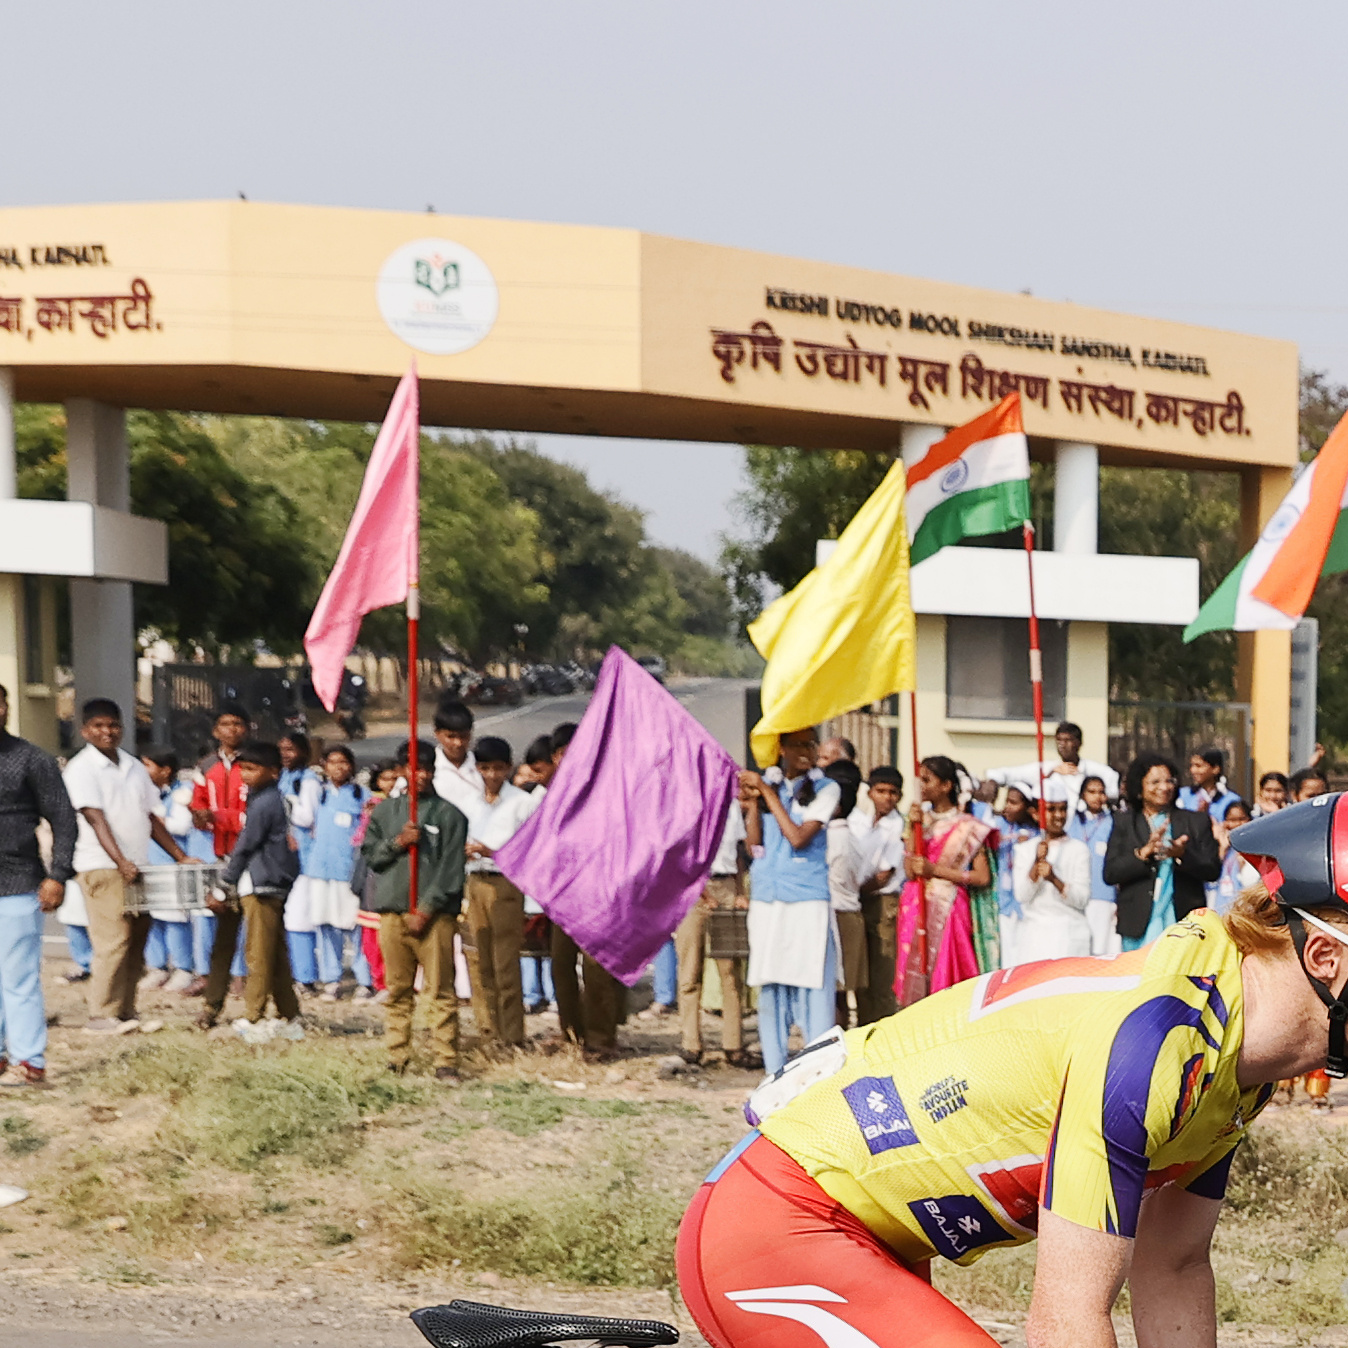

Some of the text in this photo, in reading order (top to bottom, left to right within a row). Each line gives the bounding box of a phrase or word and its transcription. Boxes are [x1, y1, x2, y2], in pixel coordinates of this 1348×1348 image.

[766, 286, 829, 317] KRISHI
[836, 296, 901, 328] UDYOG
[909, 311, 961, 337] MOOL
[968, 321, 1054, 354] SHIKSHAN
[711, 321, 783, 384] कृषि
[793, 331, 888, 387] उद्योग
[897, 355, 952, 410] मूल
[960, 353, 1050, 409] शिक्षण
[923, 1200, 968, 1253] BAJAJ
